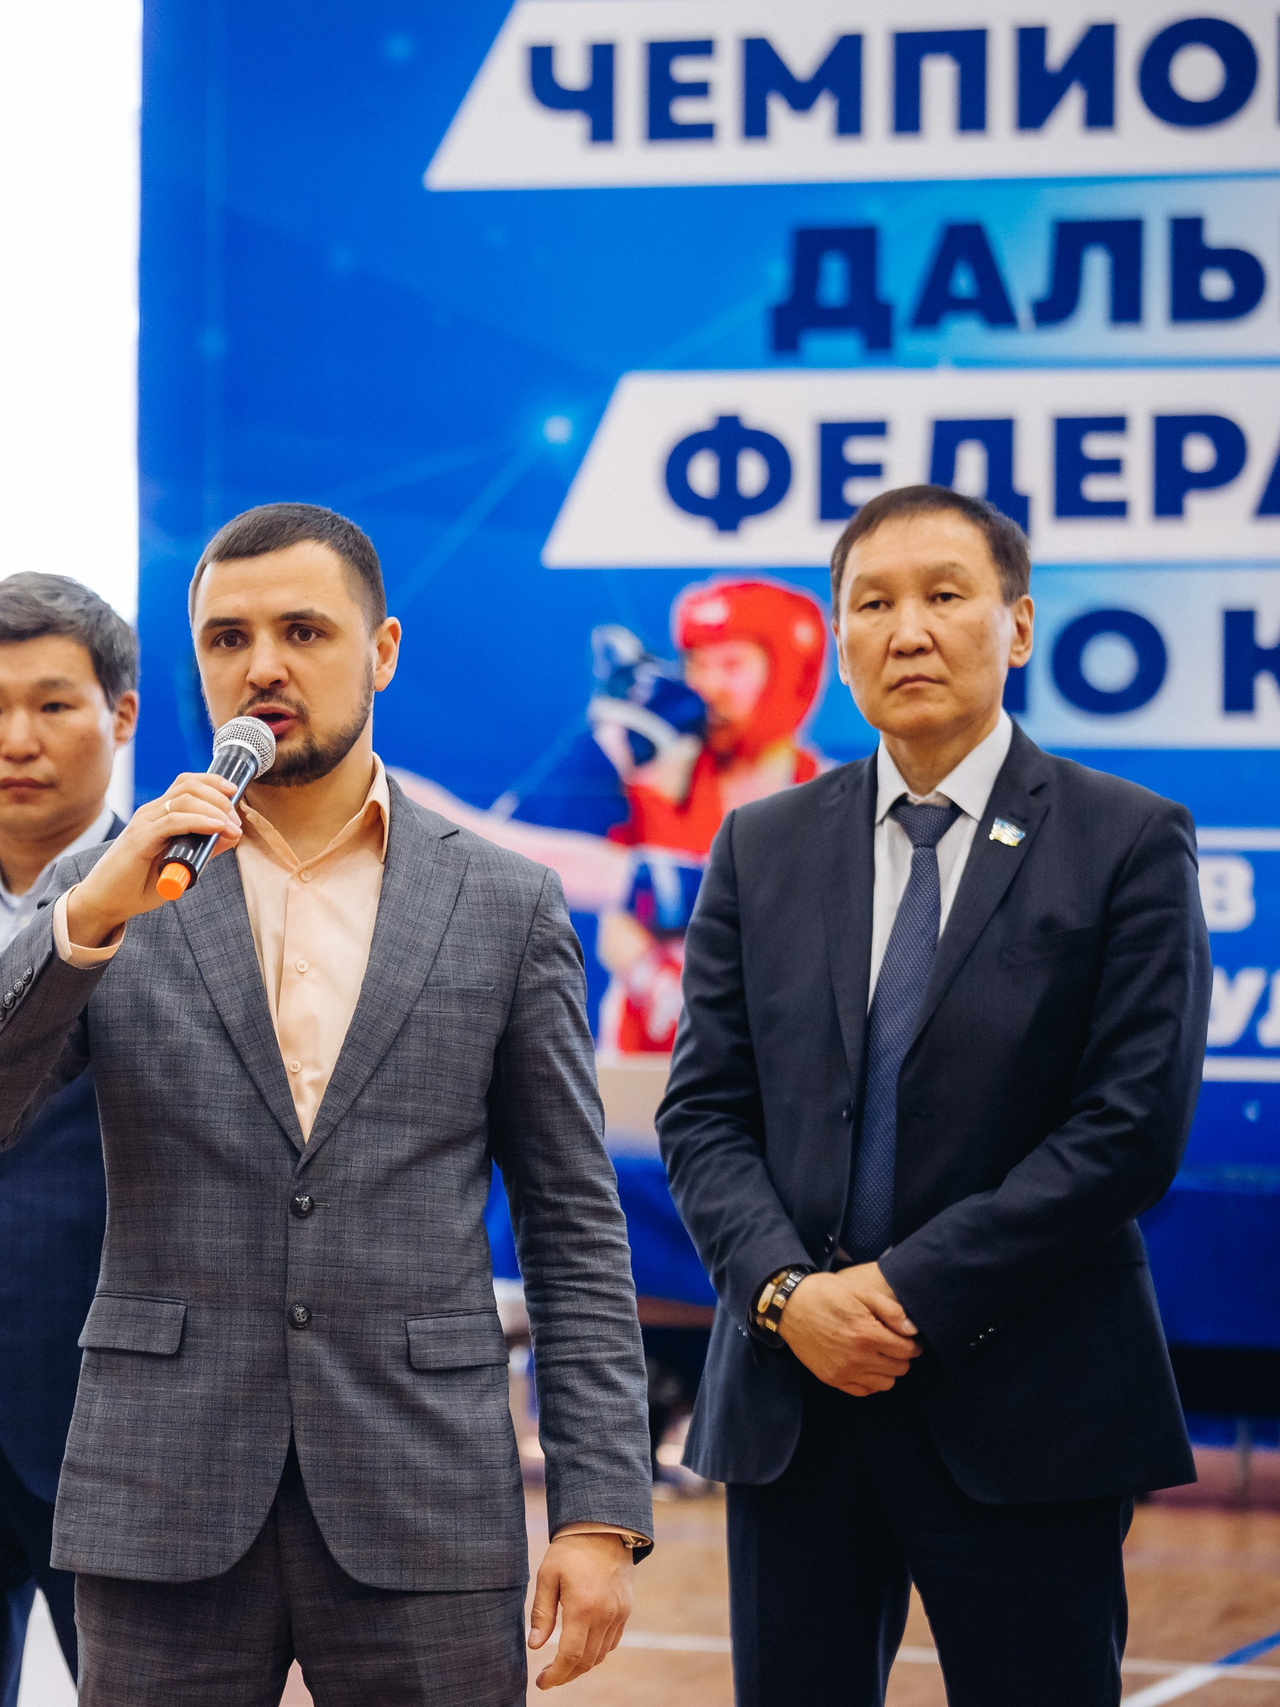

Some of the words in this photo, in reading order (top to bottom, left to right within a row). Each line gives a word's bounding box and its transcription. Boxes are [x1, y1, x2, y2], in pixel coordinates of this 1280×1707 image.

[527, 16, 1280, 146] ЧЕМПИО
[663, 413, 1280, 536] ФЕДЕР
[1002, 608, 1169, 717] О
